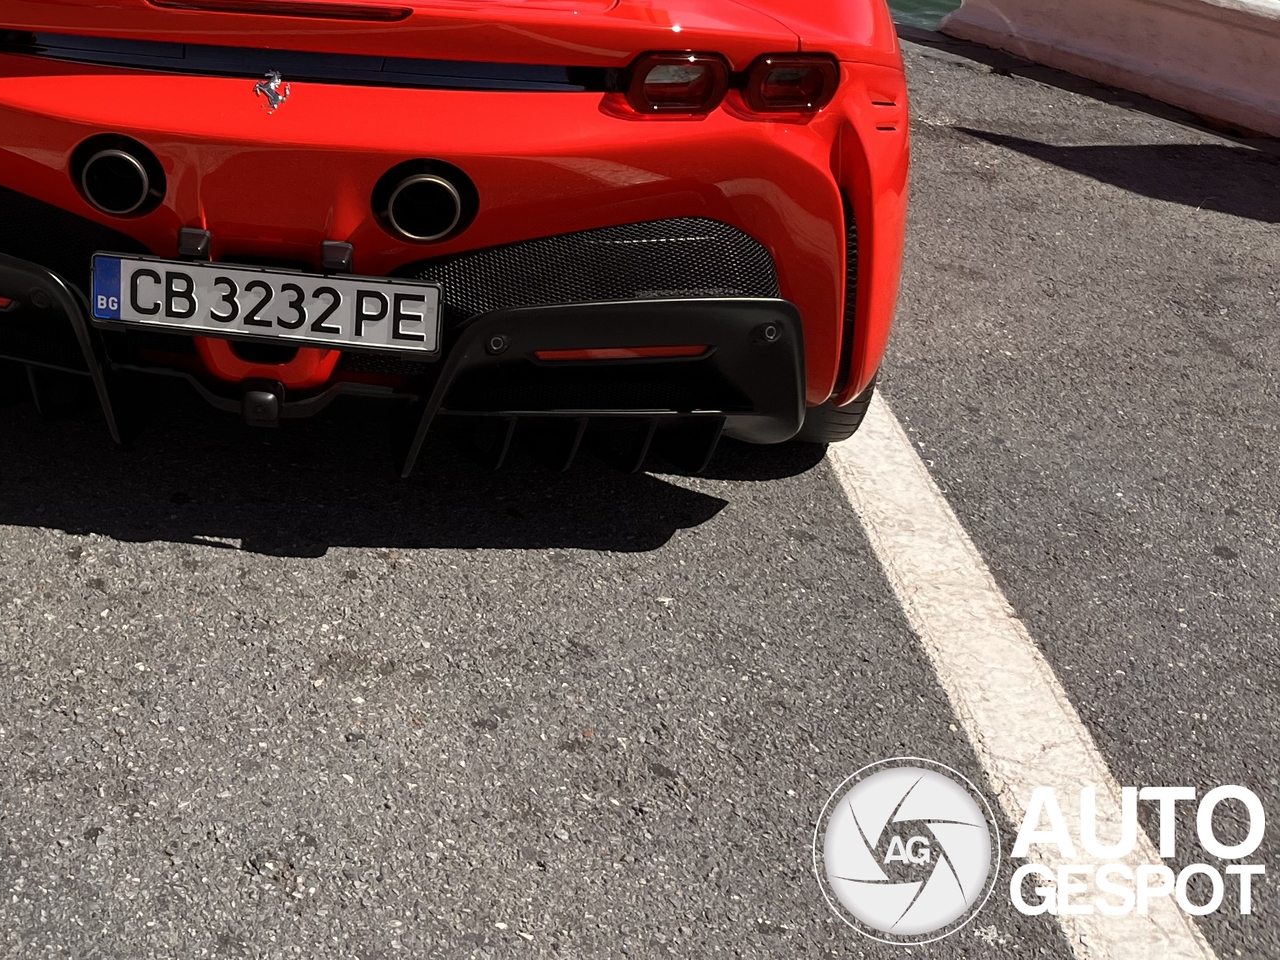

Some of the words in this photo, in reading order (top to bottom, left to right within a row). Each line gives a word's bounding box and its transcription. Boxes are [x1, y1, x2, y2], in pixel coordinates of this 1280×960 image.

[96, 294, 119, 311] BG
[129, 268, 198, 320] CB
[209, 276, 343, 335] 3232
[353, 289, 426, 342] PE
